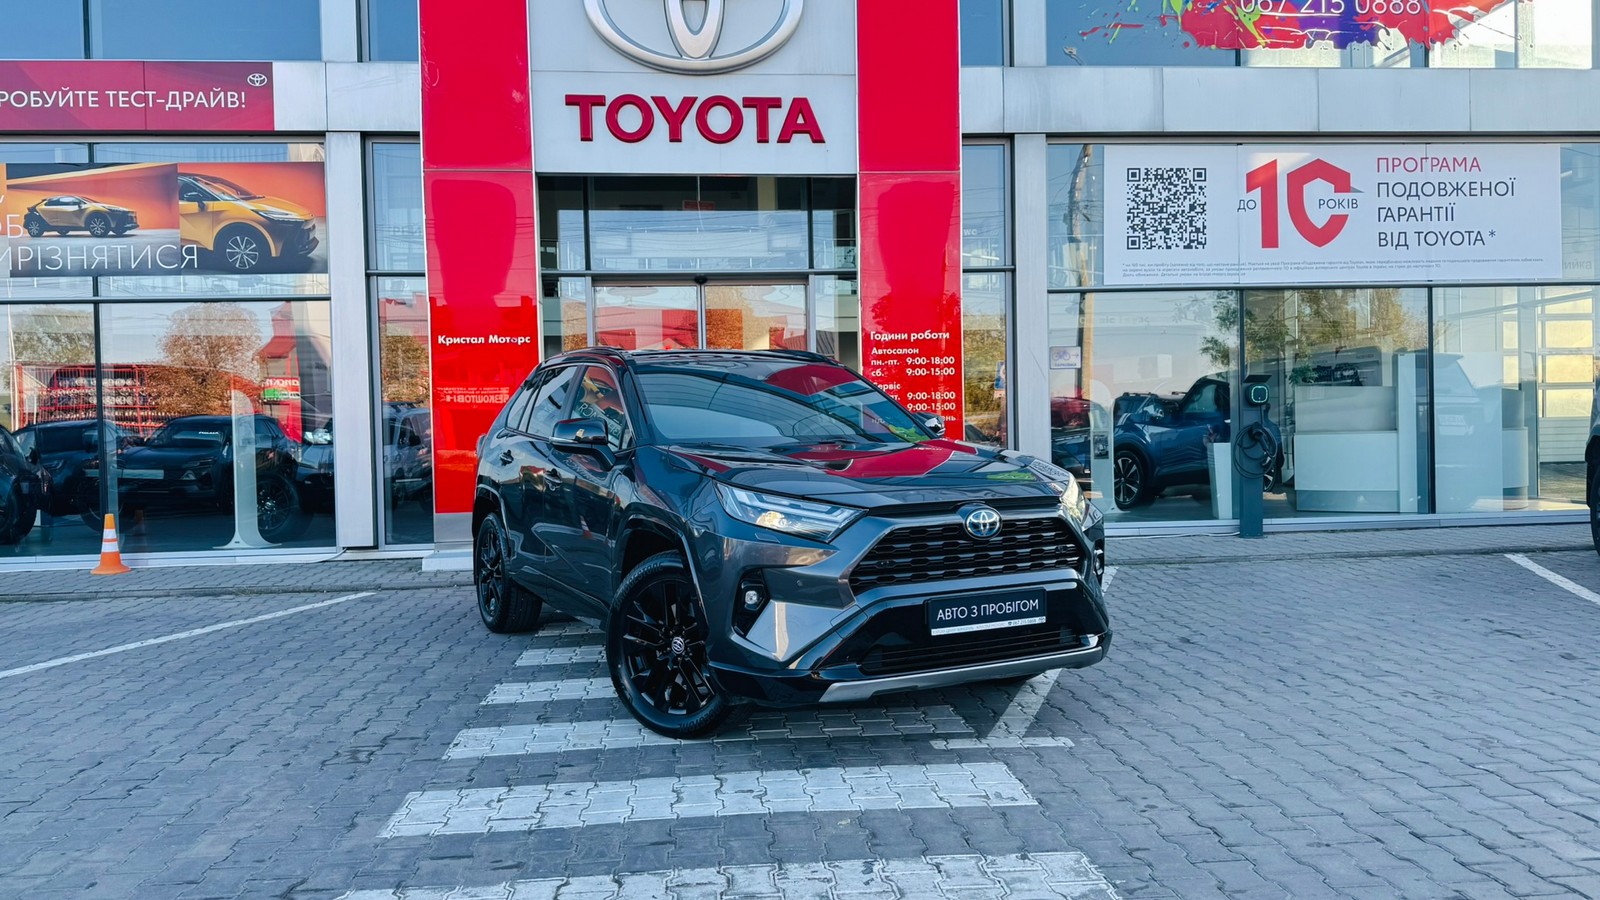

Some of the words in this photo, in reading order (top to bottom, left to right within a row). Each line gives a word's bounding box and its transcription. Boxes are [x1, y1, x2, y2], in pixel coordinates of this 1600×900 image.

[1240, 0, 1285, 13] 067
[1300, 0, 1345, 13] 215
[1355, 0, 1421, 14] 0888
[105, 87, 246, 111] ТЕСТ-ДРАЙВ!
[565, 93, 826, 144] TOYOTA
[1377, 157, 1481, 173] ПРОГРАМА
[1377, 177, 1516, 201] ПОДОВЖЕНОЇ
[1237, 199, 1257, 212] ДО
[1318, 198, 1359, 209] РОКІВ
[1377, 202, 1456, 222] ГАРАНТІЇ
[1378, 231, 1409, 250] ВІД
[438, 335, 485, 346] Кристал
[488, 335, 531, 345] Моторс
[870, 331, 908, 341] Години
[911, 330, 950, 342] роботи
[906, 356, 955, 365] 9:00-18:00
[871, 368, 884, 377] сб.
[906, 367, 955, 376] 9:00-15:00
[907, 392, 956, 400] 9:00-18:00
[907, 402, 956, 411] 9:00-15:00
[937, 606, 968, 621] АВТО
[980, 599, 1039, 616] ПРОБІГОМ
